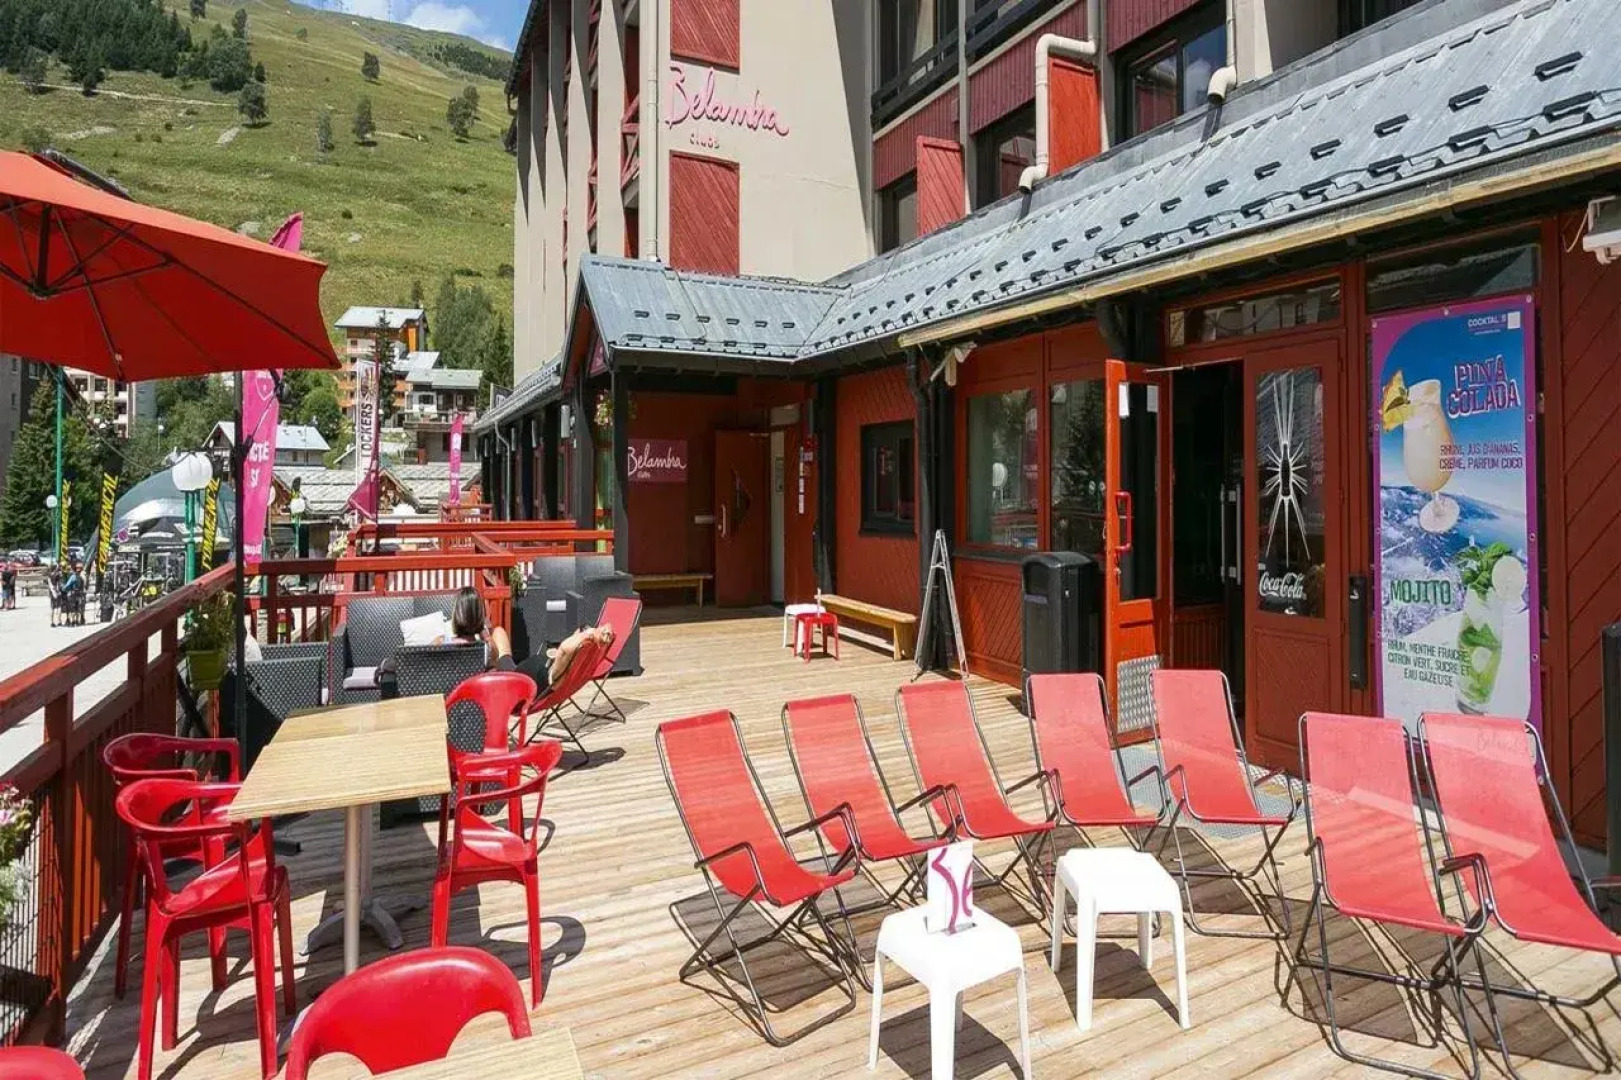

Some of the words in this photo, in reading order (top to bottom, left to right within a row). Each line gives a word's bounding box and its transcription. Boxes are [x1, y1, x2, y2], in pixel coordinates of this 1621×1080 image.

[1447, 379, 1521, 419] COLADA
[1501, 456, 1523, 469] COCO
[1390, 579, 1452, 605] MOJITO
[1403, 668, 1418, 681] EAU
